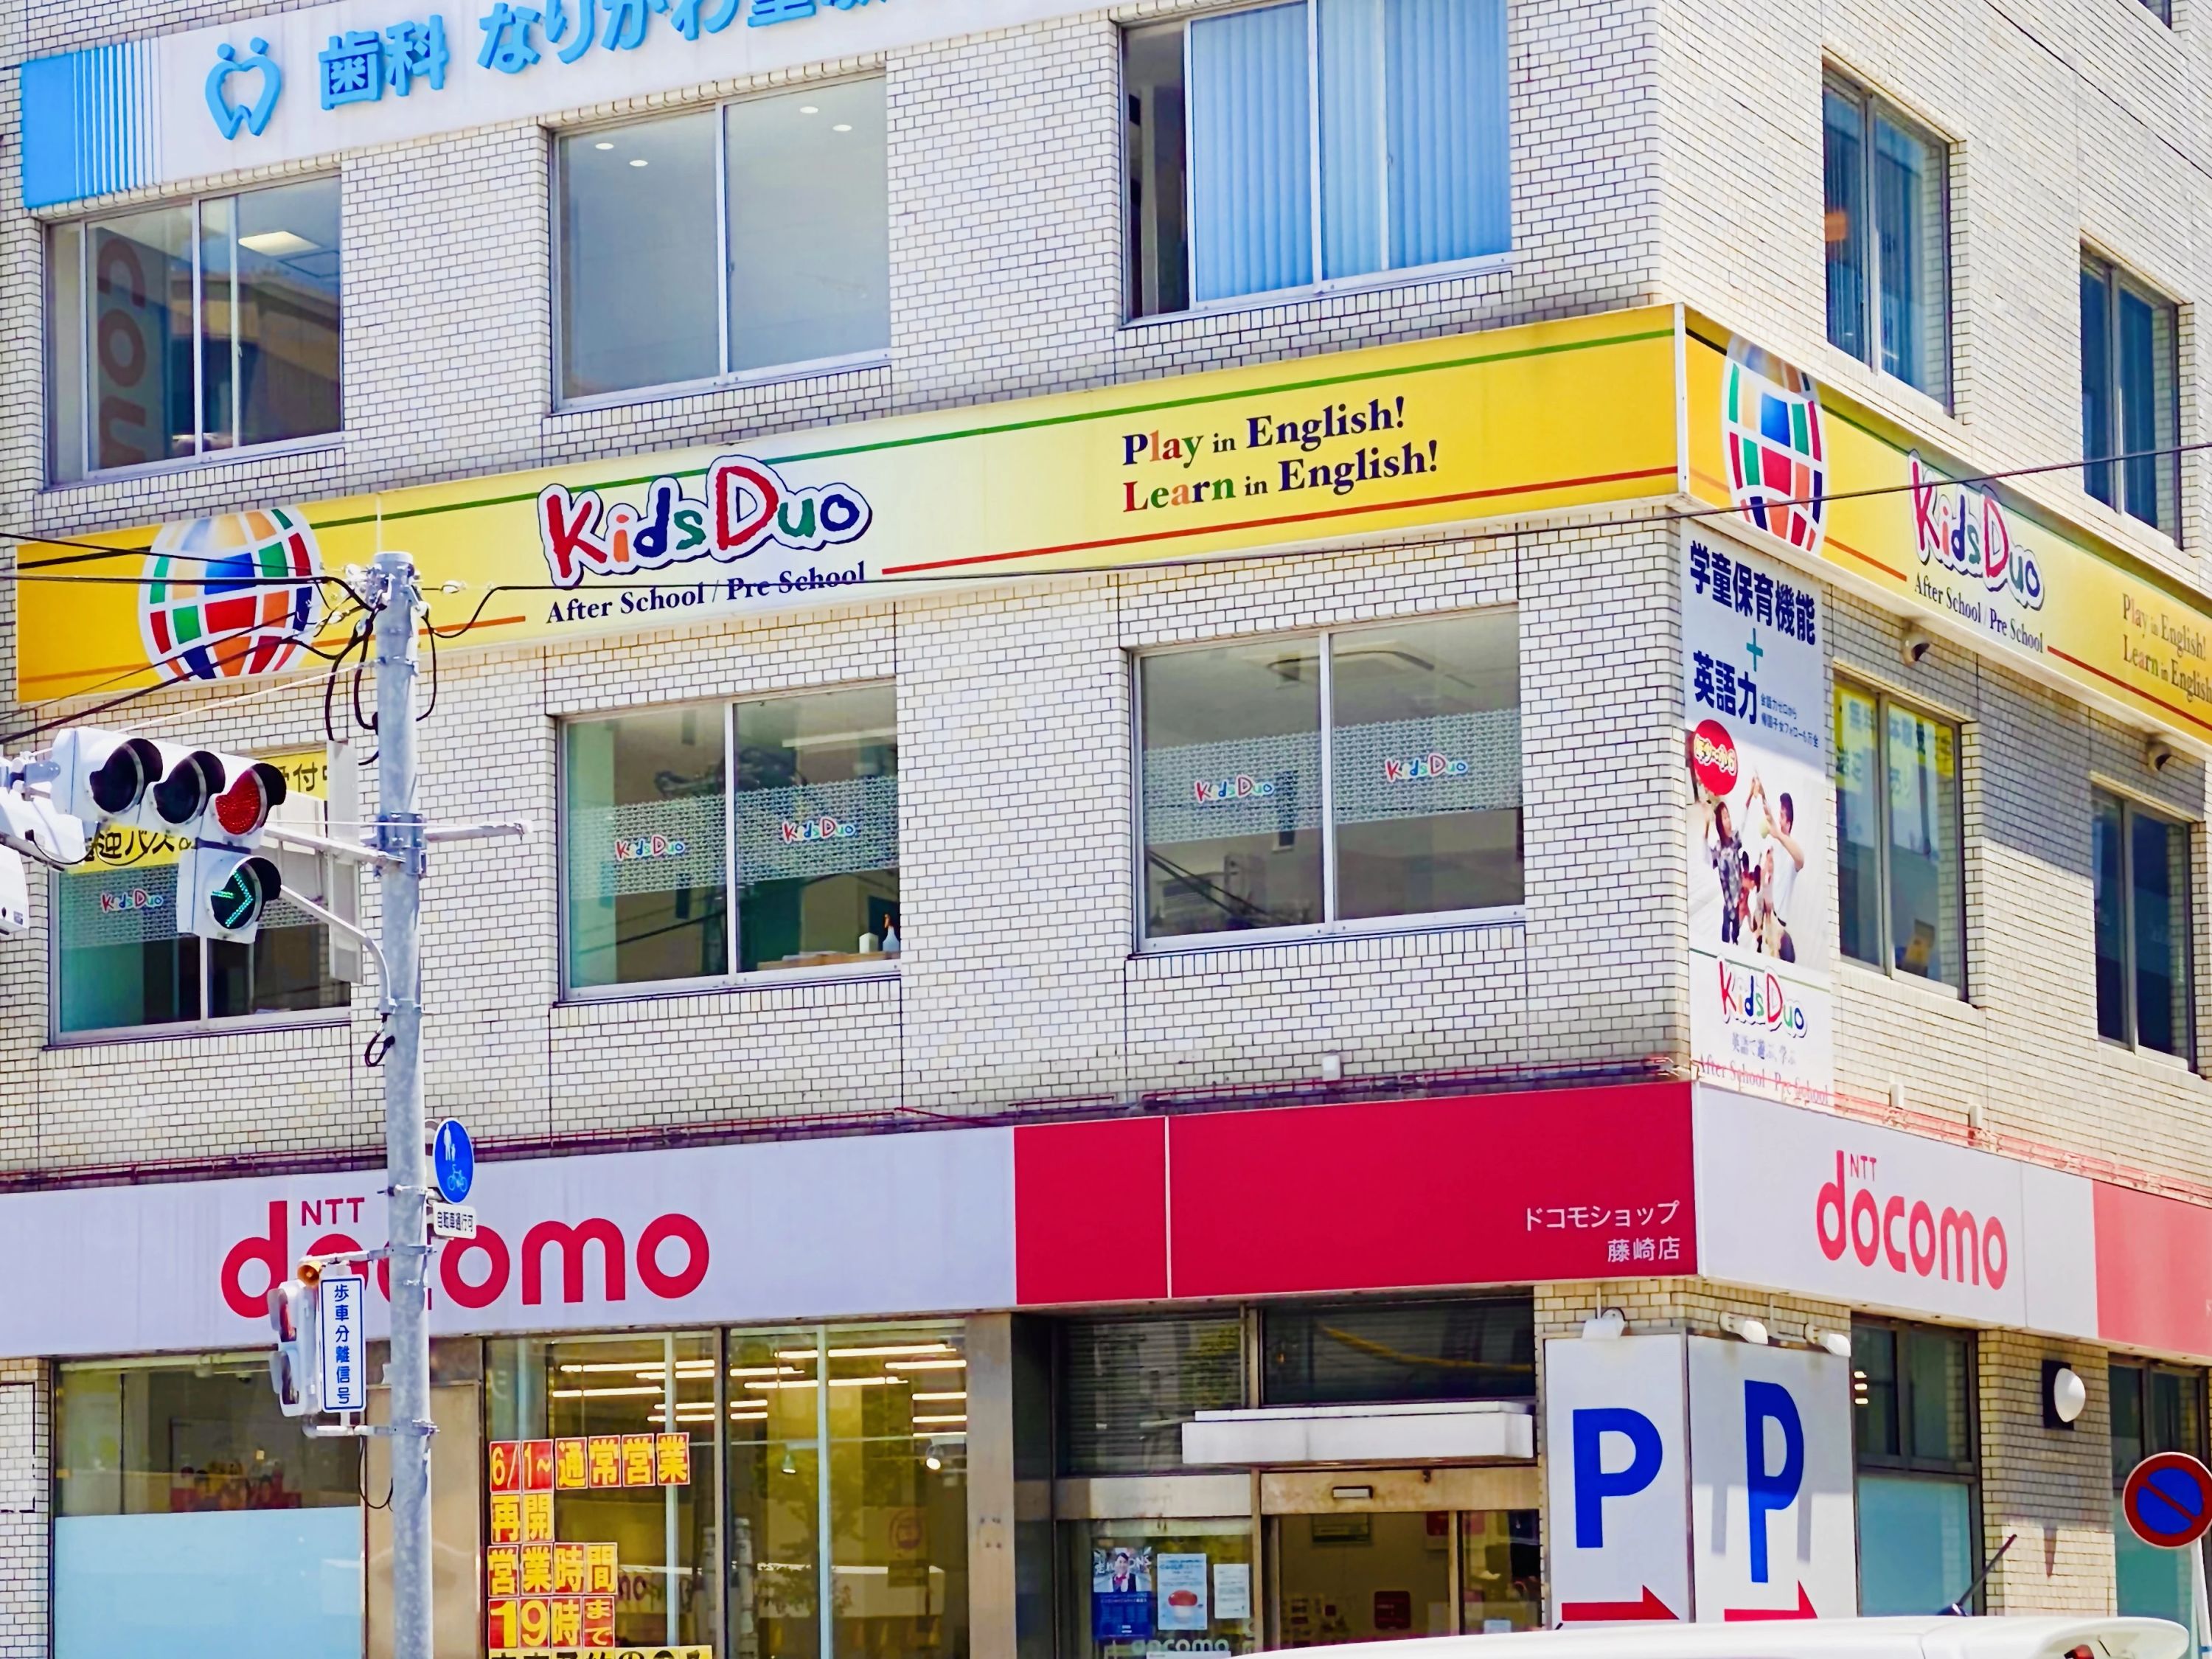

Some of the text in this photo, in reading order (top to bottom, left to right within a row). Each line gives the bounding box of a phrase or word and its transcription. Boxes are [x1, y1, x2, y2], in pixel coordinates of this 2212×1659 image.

[319, 15, 448, 110] 歯科
[1122, 396, 1405, 469] Play in English!
[1123, 439, 1439, 512] Learn in English!
[542, 459, 866, 586] KidsDuo
[1910, 455, 2042, 605] KidsDuo
[546, 596, 613, 624] After
[620, 585, 704, 613] School
[727, 577, 771, 602] Pre
[778, 562, 866, 594] School
[1690, 540, 1815, 645] 学童保育機能
[1915, 572, 1944, 604] After
[1947, 588, 1981, 623] School
[1990, 608, 2007, 636] Pre
[2010, 618, 2044, 653] School
[2123, 594, 2206, 661] Play in English!
[1693, 650, 1757, 725] 英語力
[2124, 634, 2159, 677] Learn
[2161, 664, 2168, 681] in
[1718, 957, 1806, 1034] KidsDuo
[1850, 1152, 1877, 1182] NTT
[301, 1197, 366, 1226] NTT
[1526, 1200, 1680, 1232] ドコモショップ
[1816, 1150, 2008, 1290] docomo
[1607, 1236, 1680, 1263] 藤崎店
[334, 1284, 350, 1405] 歩車分離信号
[1573, 1408, 1663, 1548] P
[1744, 1379, 1804, 1583] P
[493, 1494, 553, 1542] 再開
[488, 1545, 616, 1593] 営業時間
[490, 1599, 613, 1647] 19時まで
